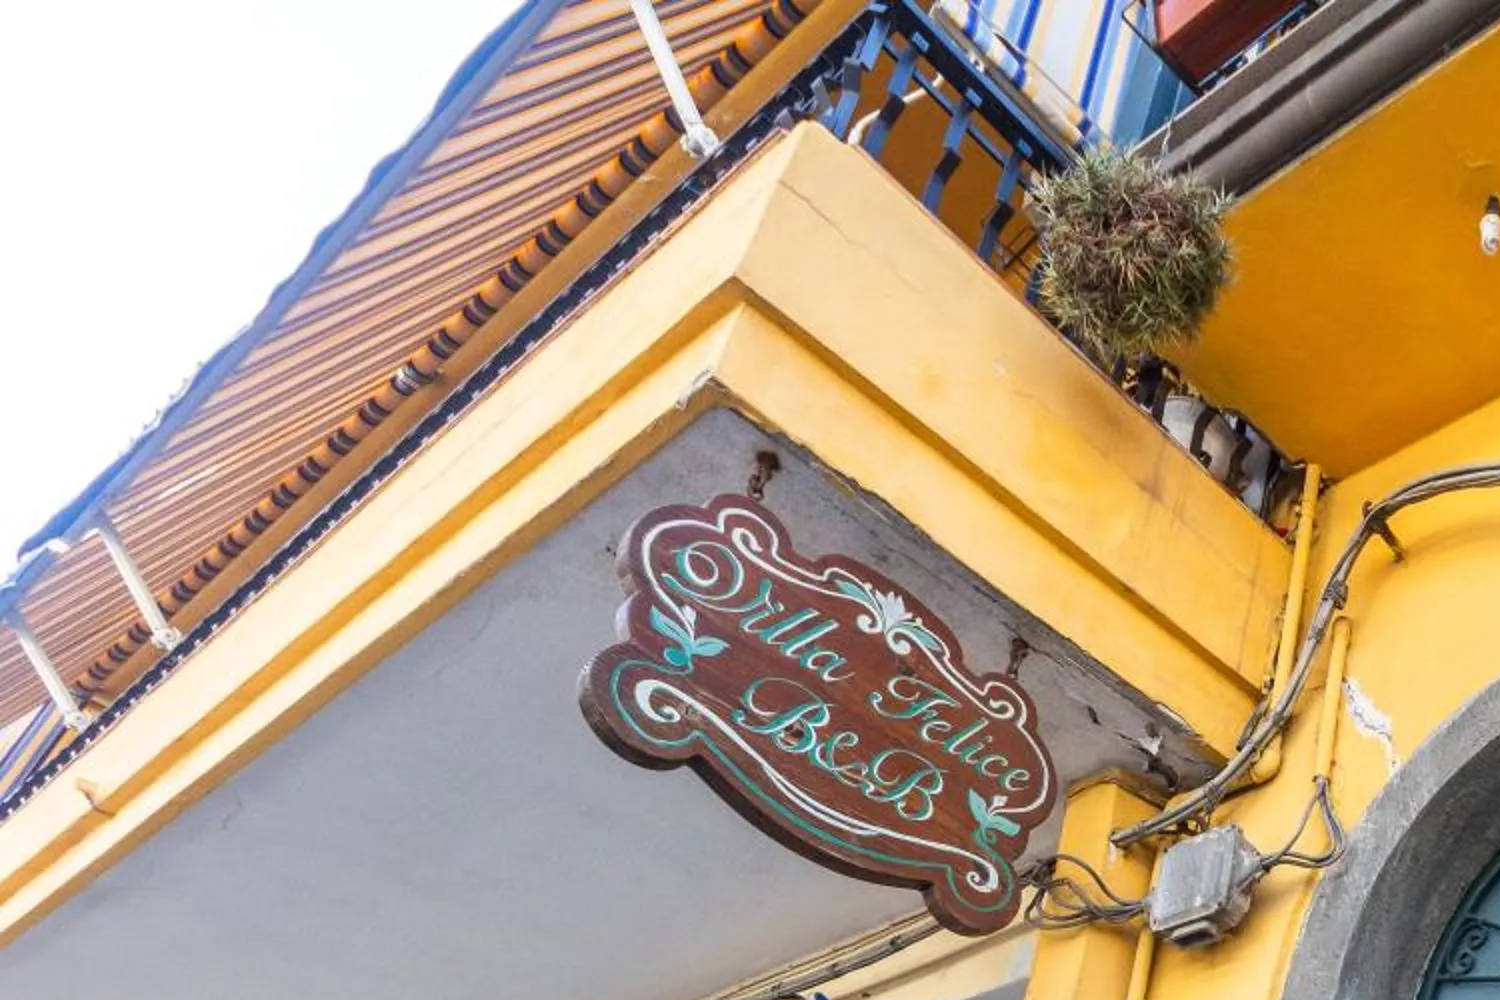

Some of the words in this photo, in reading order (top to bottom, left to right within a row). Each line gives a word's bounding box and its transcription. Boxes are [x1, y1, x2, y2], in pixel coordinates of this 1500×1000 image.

[661, 541, 853, 682] Villa
[869, 676, 1031, 793] Felice
[732, 677, 948, 821] B&B
